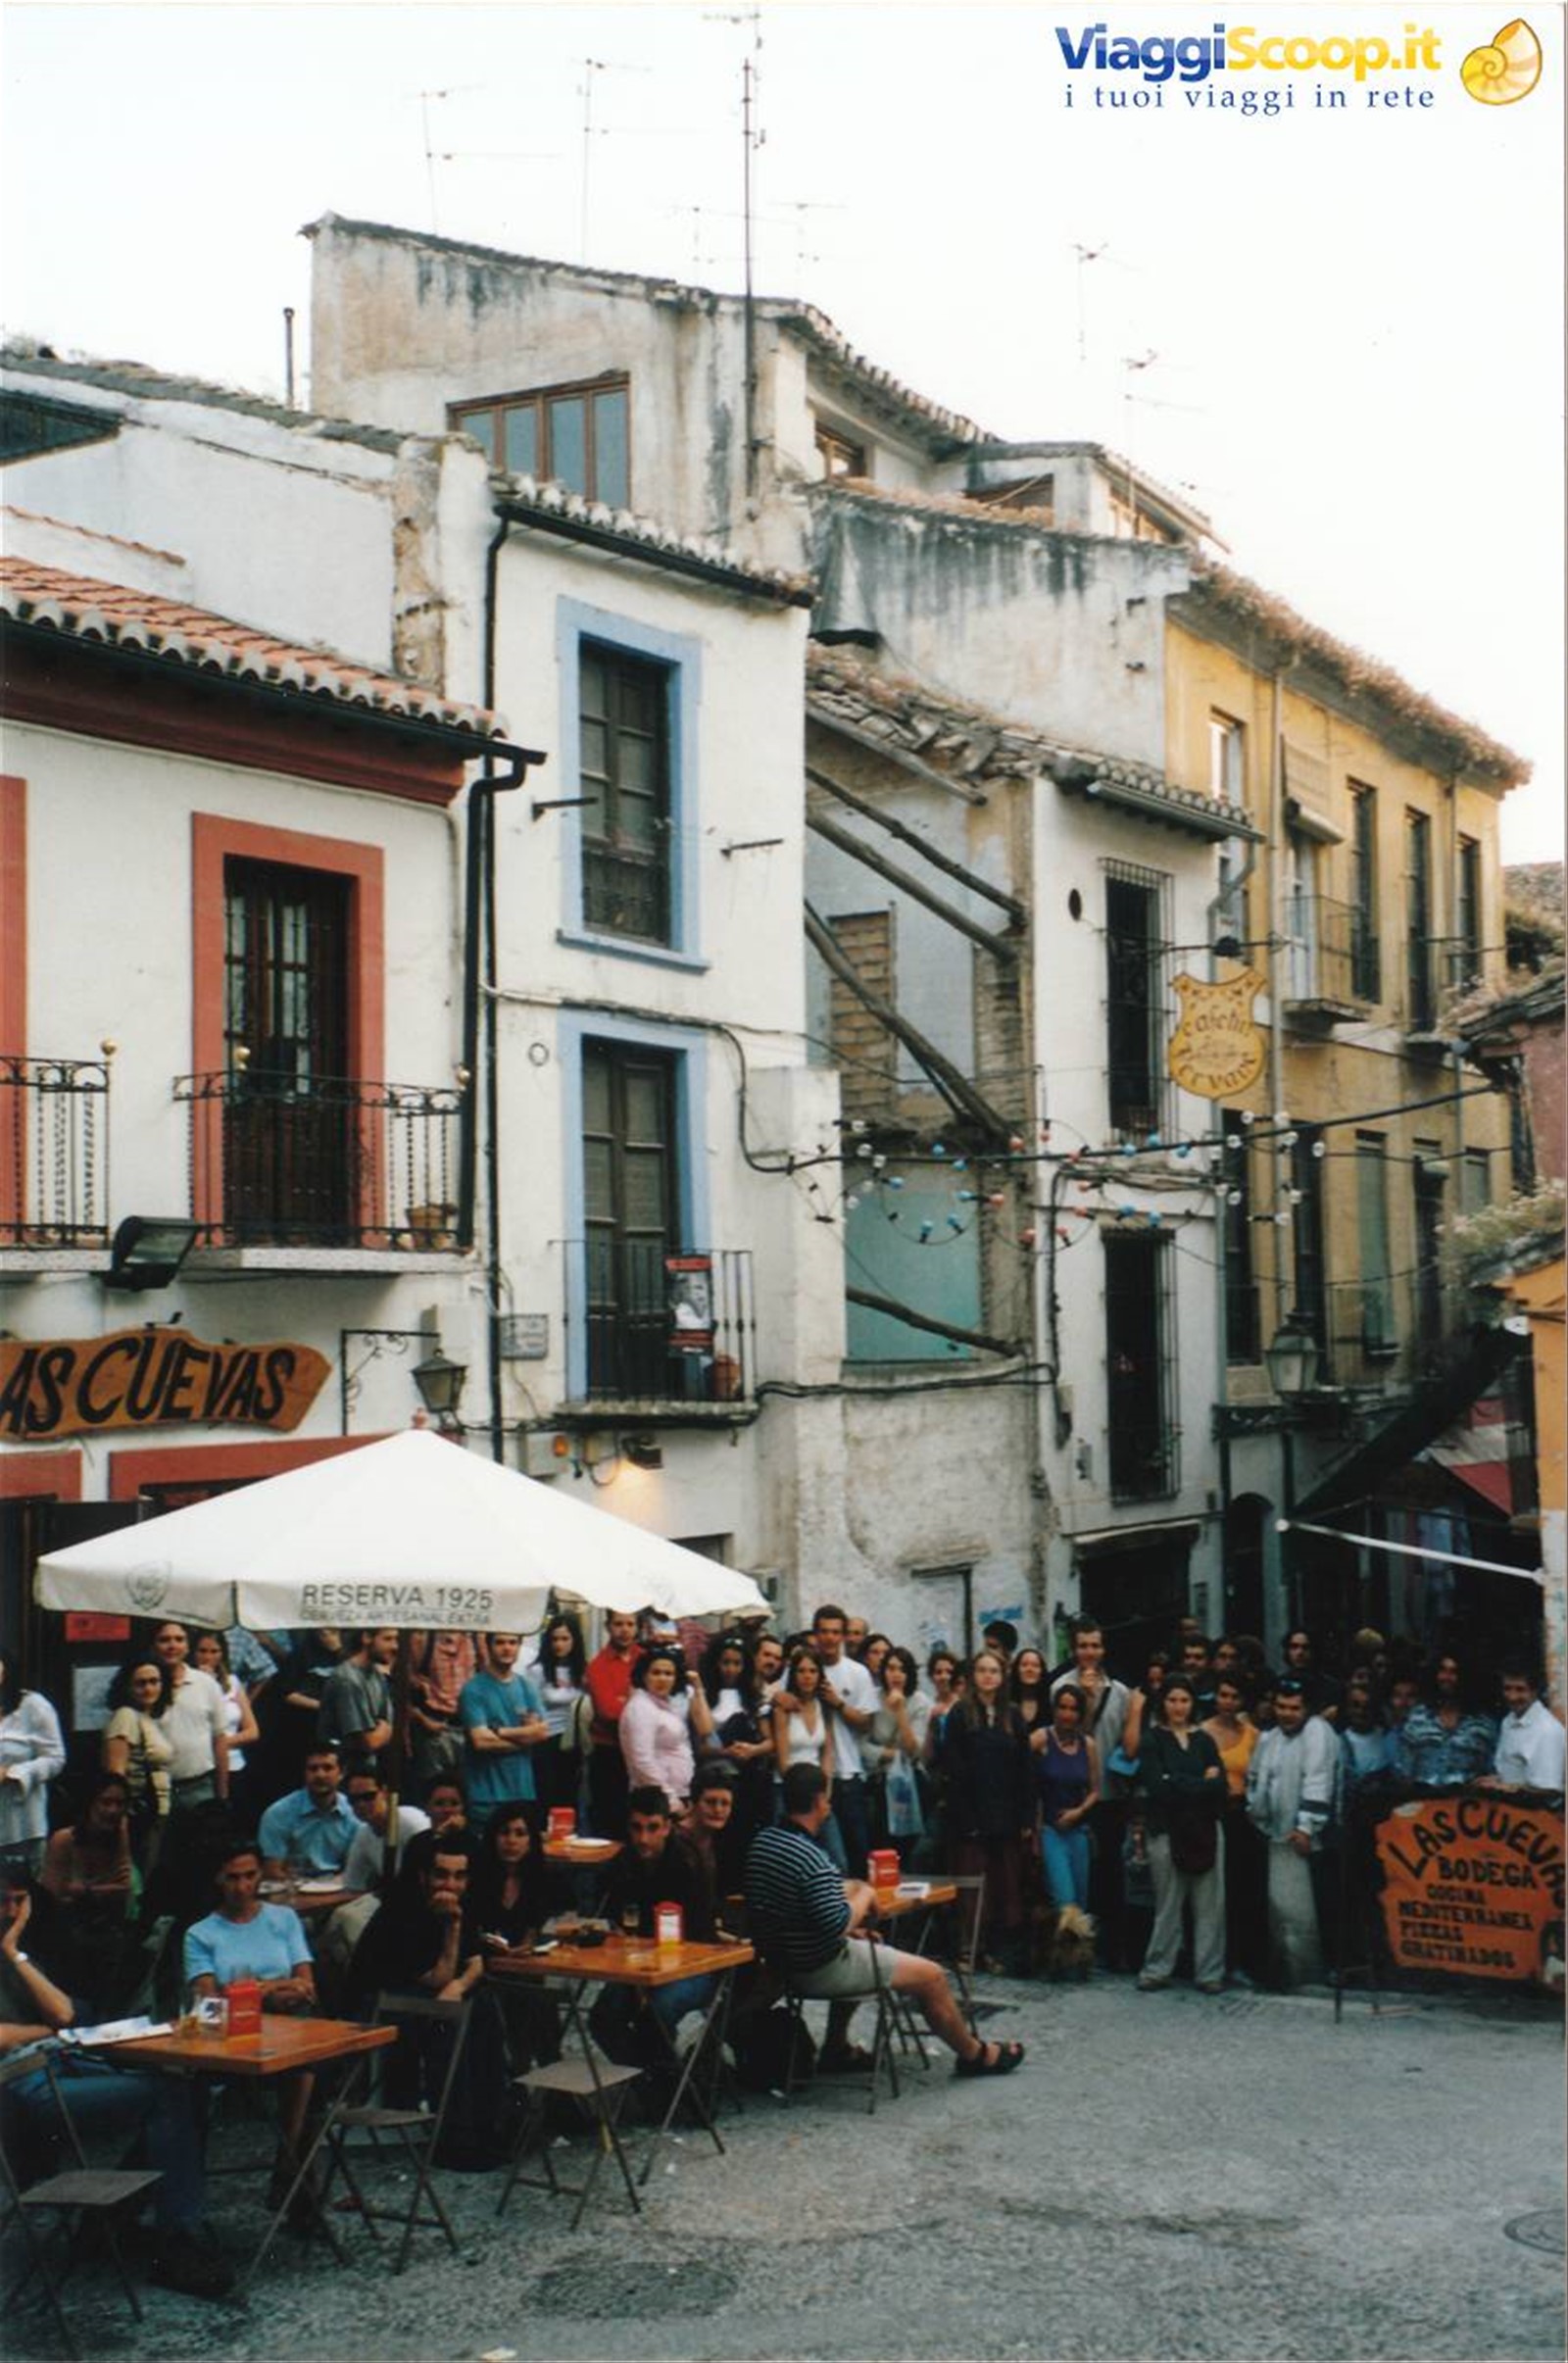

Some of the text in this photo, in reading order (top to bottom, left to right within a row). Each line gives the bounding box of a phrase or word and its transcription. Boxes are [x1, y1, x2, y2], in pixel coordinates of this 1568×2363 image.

[77, 1337, 296, 1424] CUEVAS
[303, 1584, 492, 1610] RESERVA 1925
[1388, 1811, 1457, 1879] LAS
[1441, 1857, 1536, 1890] BODEGA
